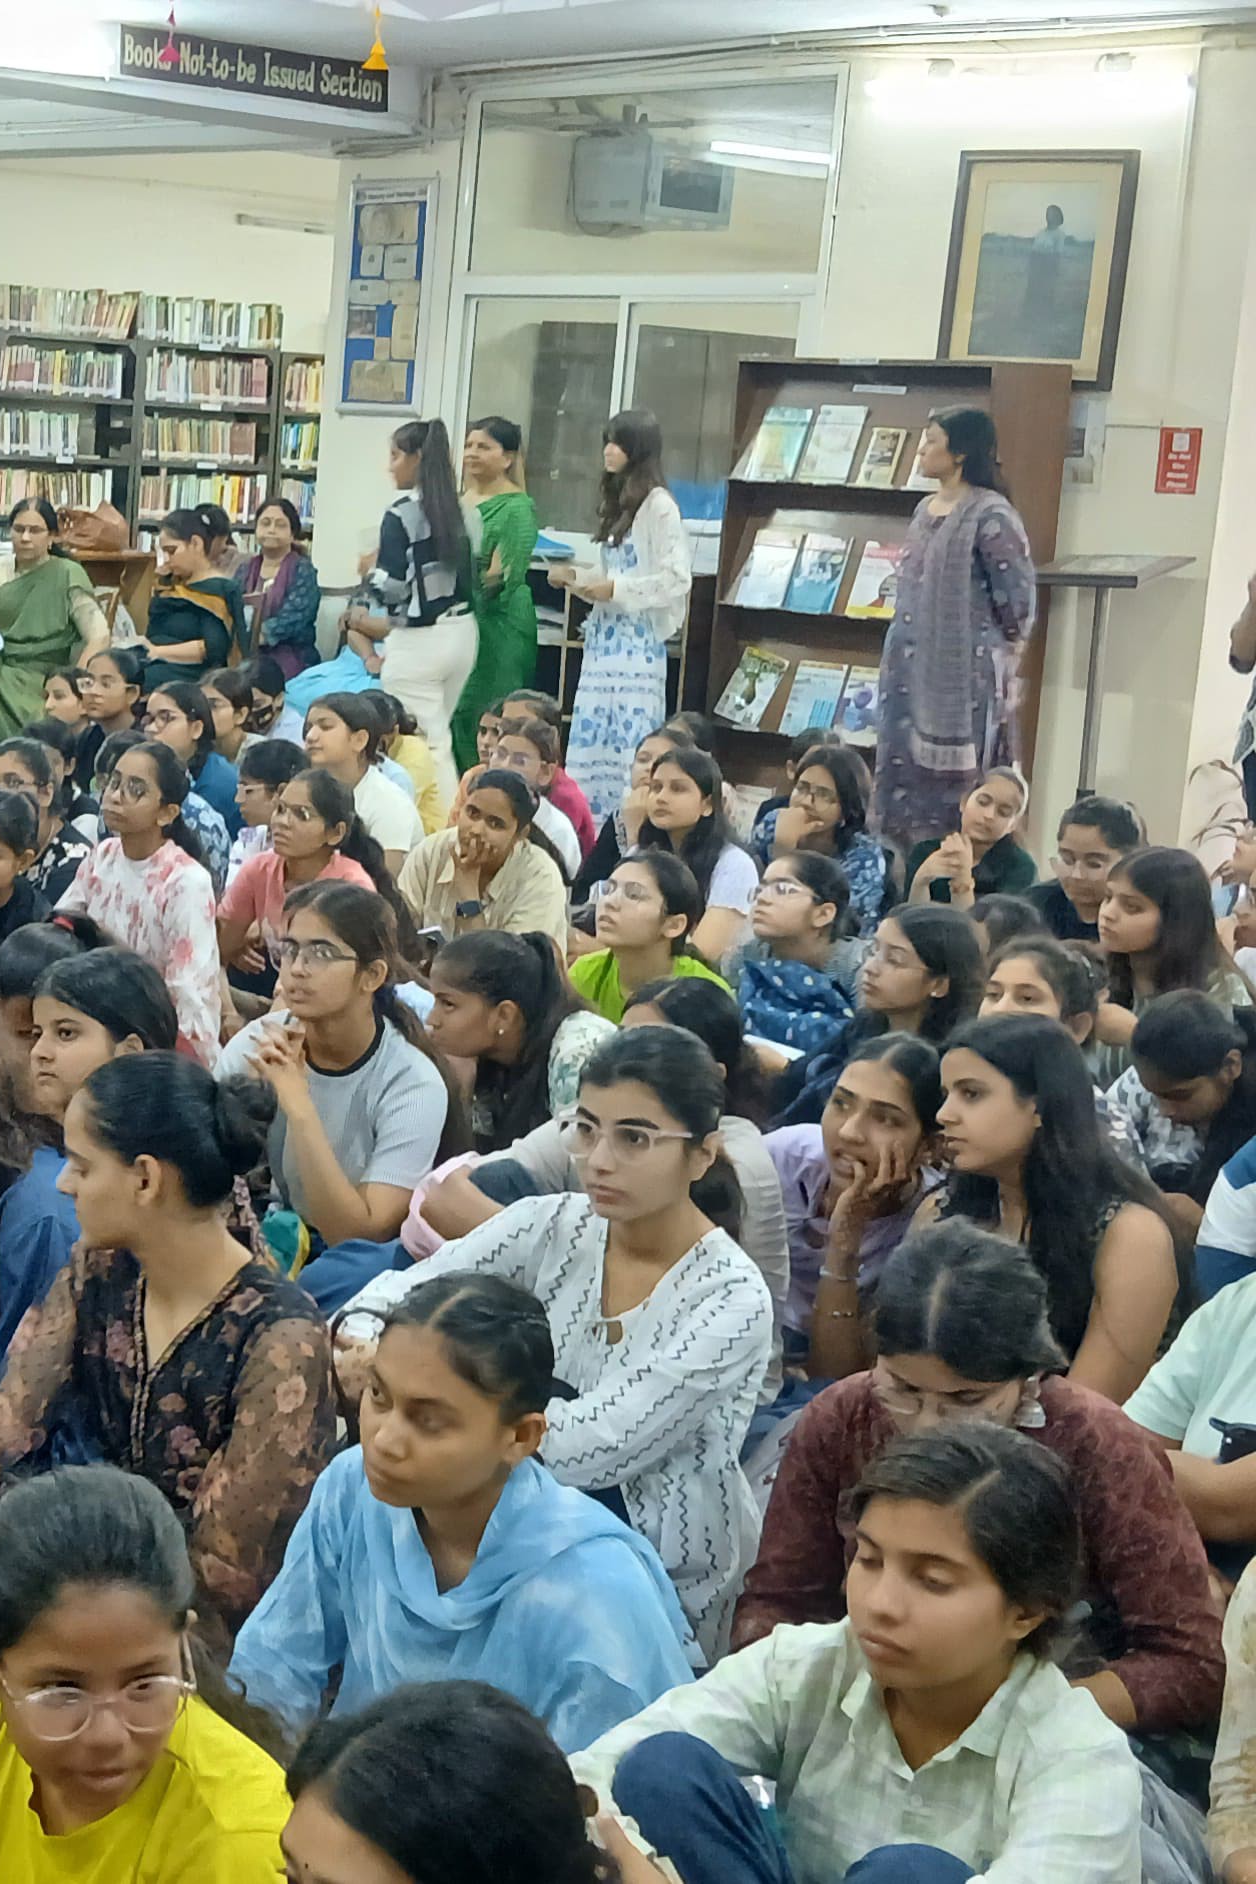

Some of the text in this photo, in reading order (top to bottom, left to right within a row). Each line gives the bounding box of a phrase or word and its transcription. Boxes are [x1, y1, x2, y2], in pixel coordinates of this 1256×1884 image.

[179, 41, 257, 83] Not-to-be
[263, 52, 315, 94] Issued
[319, 63, 383, 102] Section
